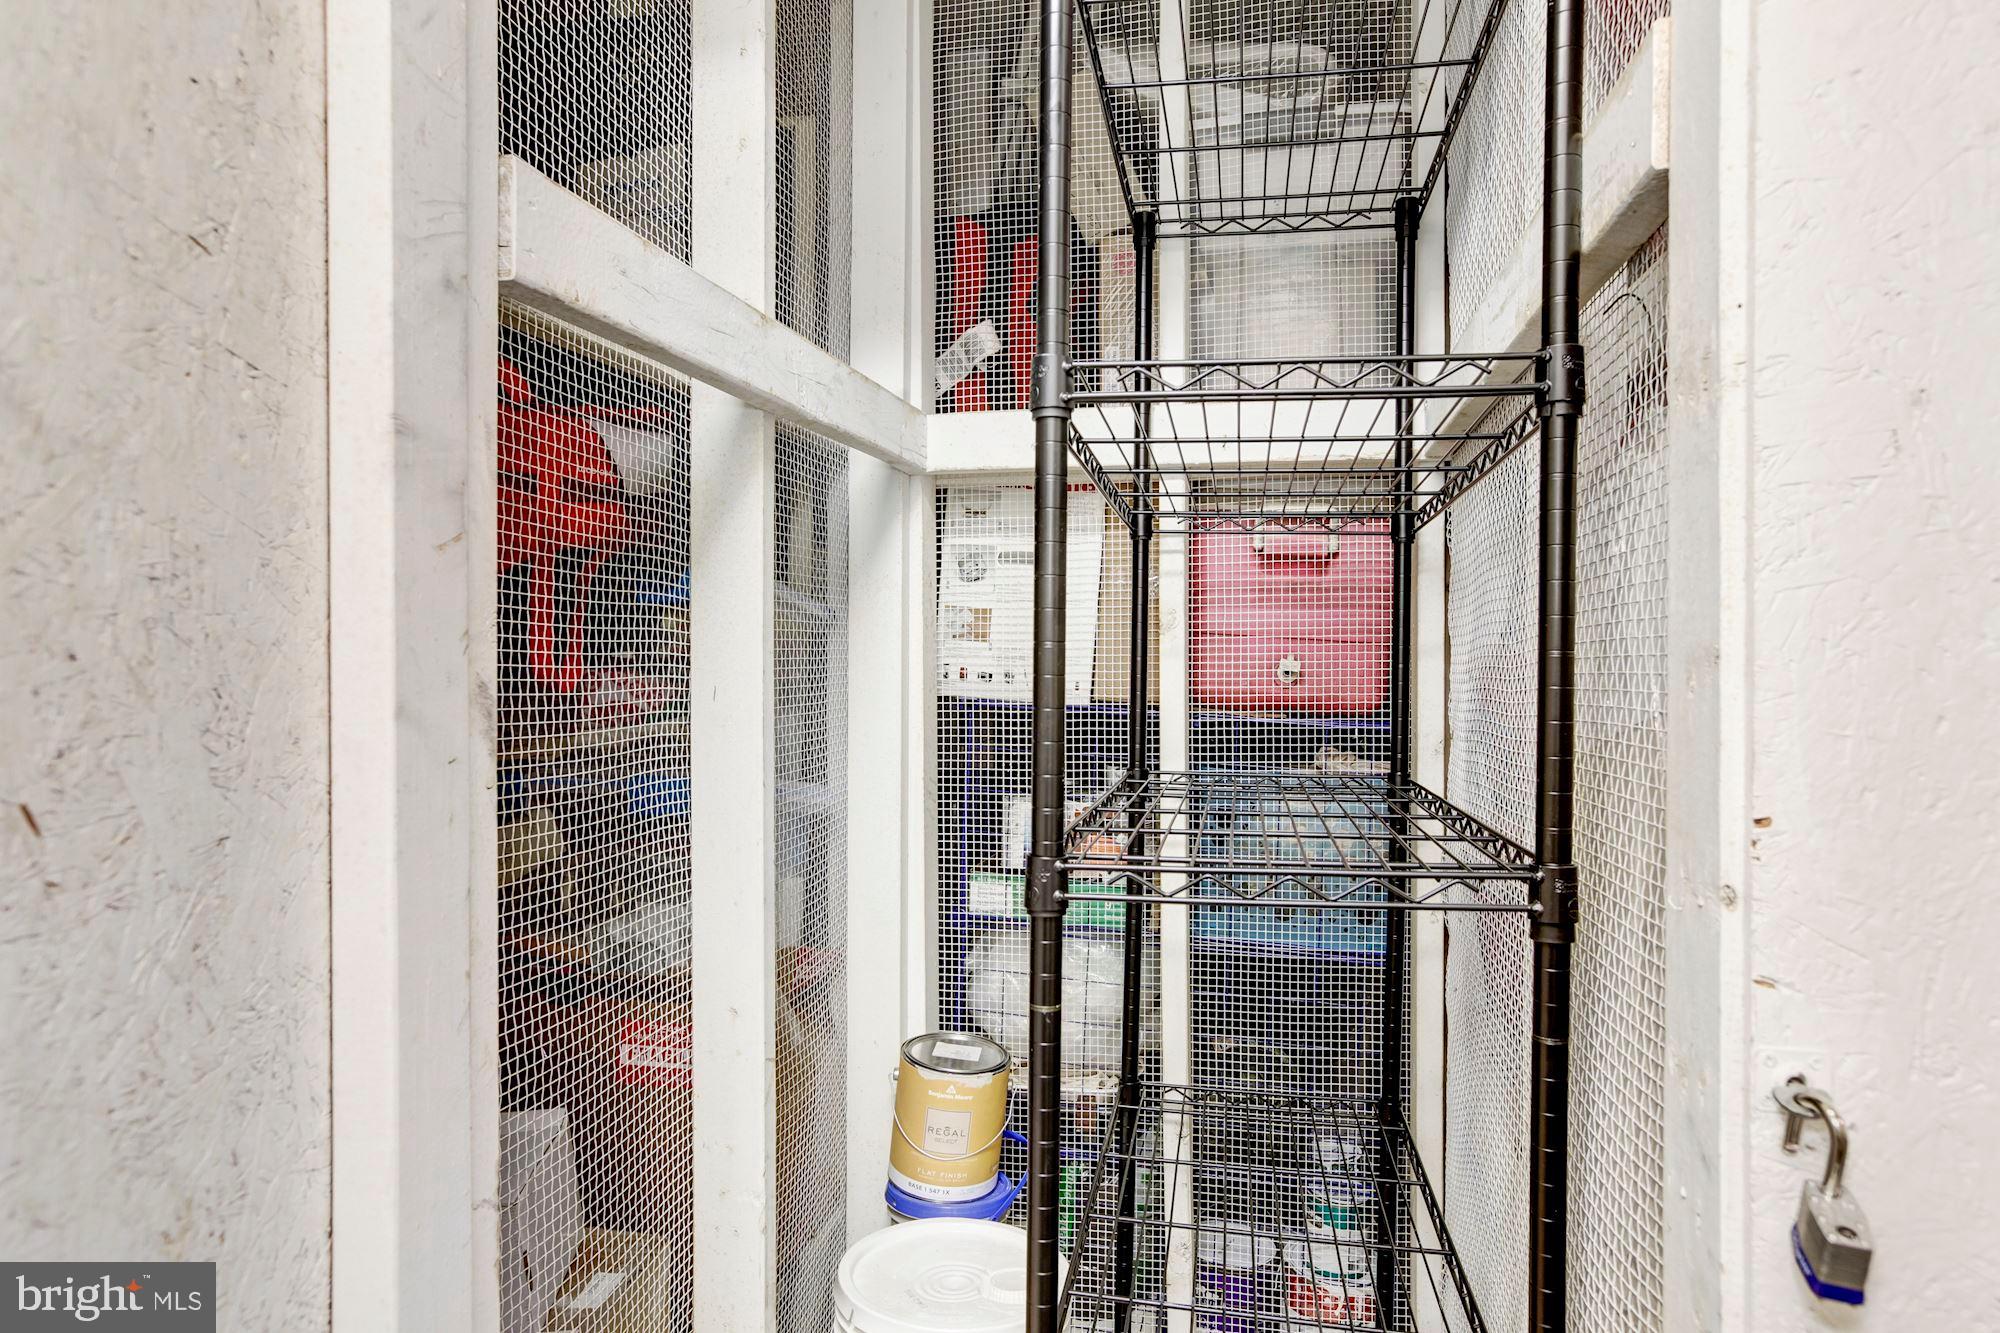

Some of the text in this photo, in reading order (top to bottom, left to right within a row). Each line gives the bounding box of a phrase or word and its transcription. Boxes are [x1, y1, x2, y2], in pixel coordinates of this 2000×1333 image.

[927, 1125, 966, 1137] REGAL
[917, 1167, 936, 1177] FLAT
[940, 1171, 968, 1179] FINISH
[908, 1181, 922, 1190] BASE
